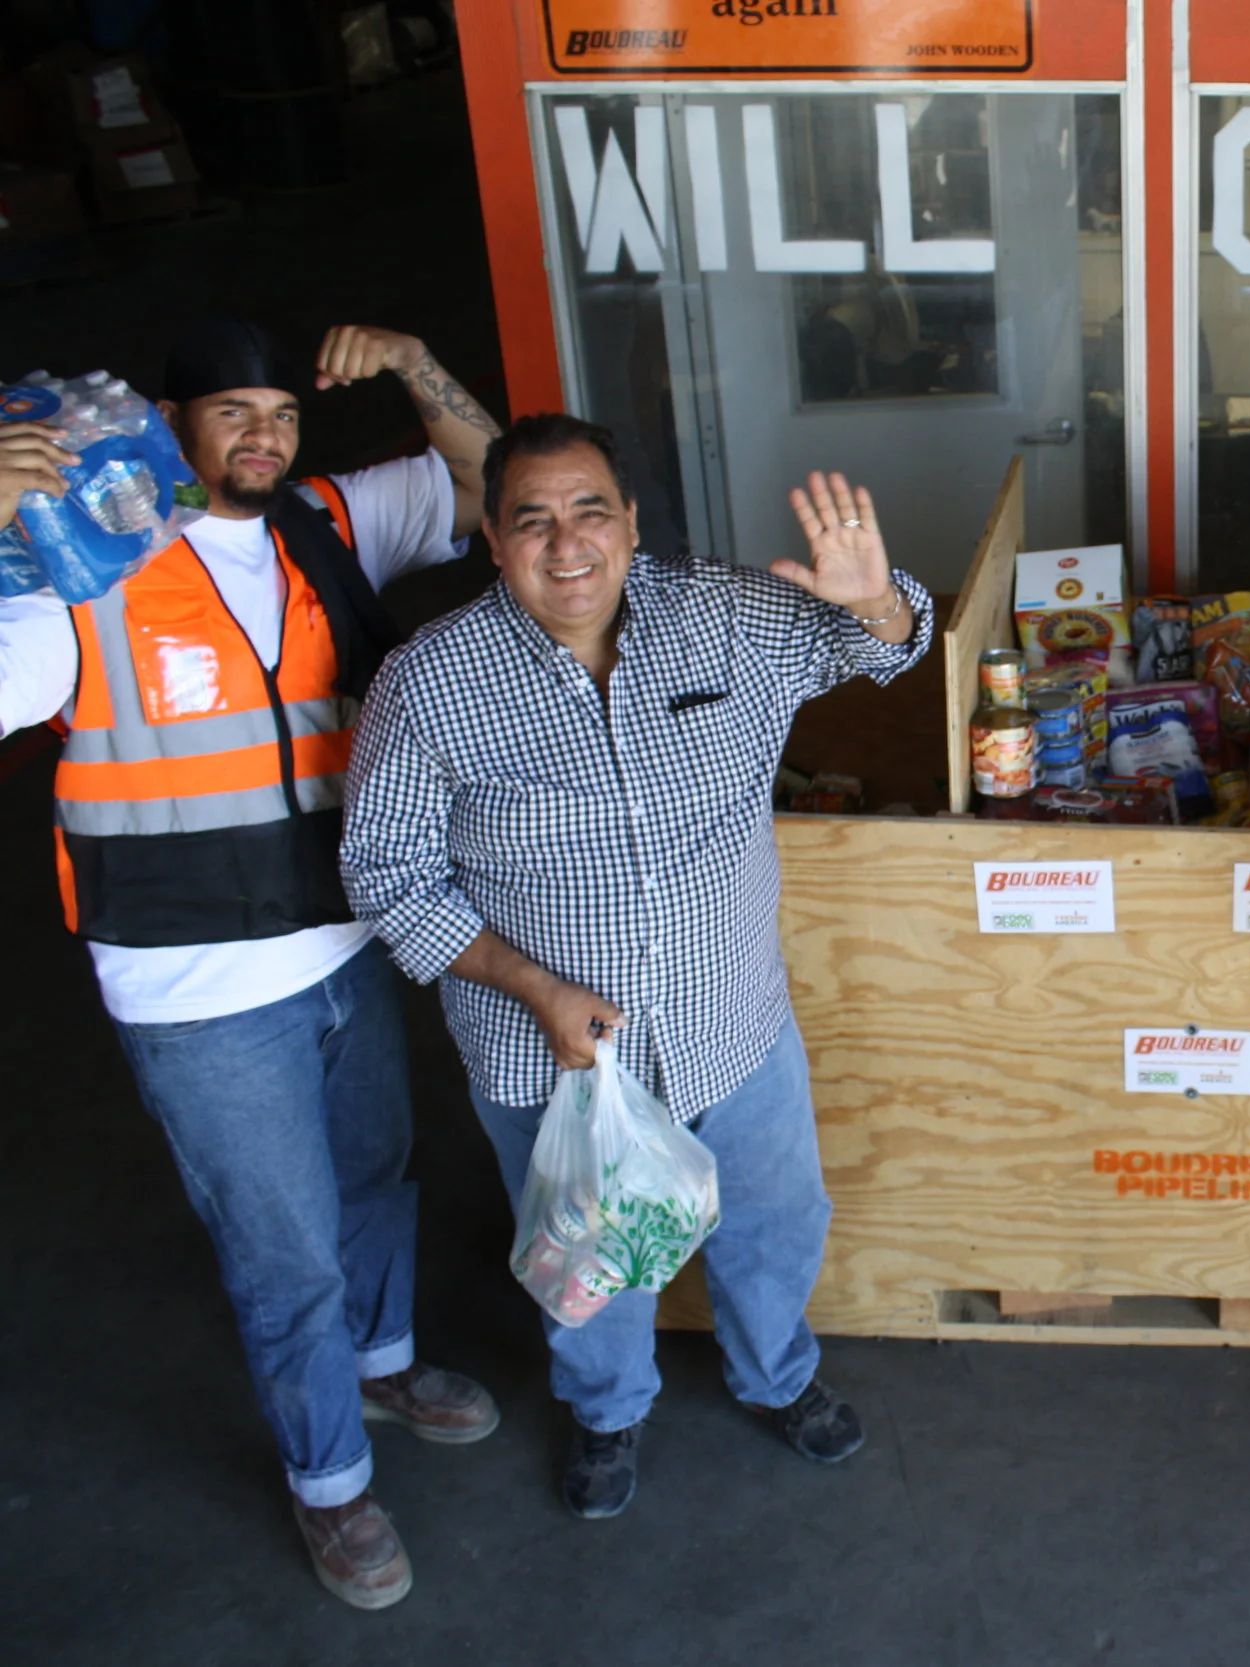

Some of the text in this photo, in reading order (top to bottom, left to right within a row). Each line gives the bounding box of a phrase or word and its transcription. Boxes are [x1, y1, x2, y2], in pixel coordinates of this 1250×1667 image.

[566, 29, 689, 56] BOUDREAU
[906, 44, 1019, 57] JOHN WOODEN
[553, 104, 996, 273] WILL
[985, 870, 1101, 892] BOUDREAU
[1134, 1036, 1245, 1055] BOUDREAU
